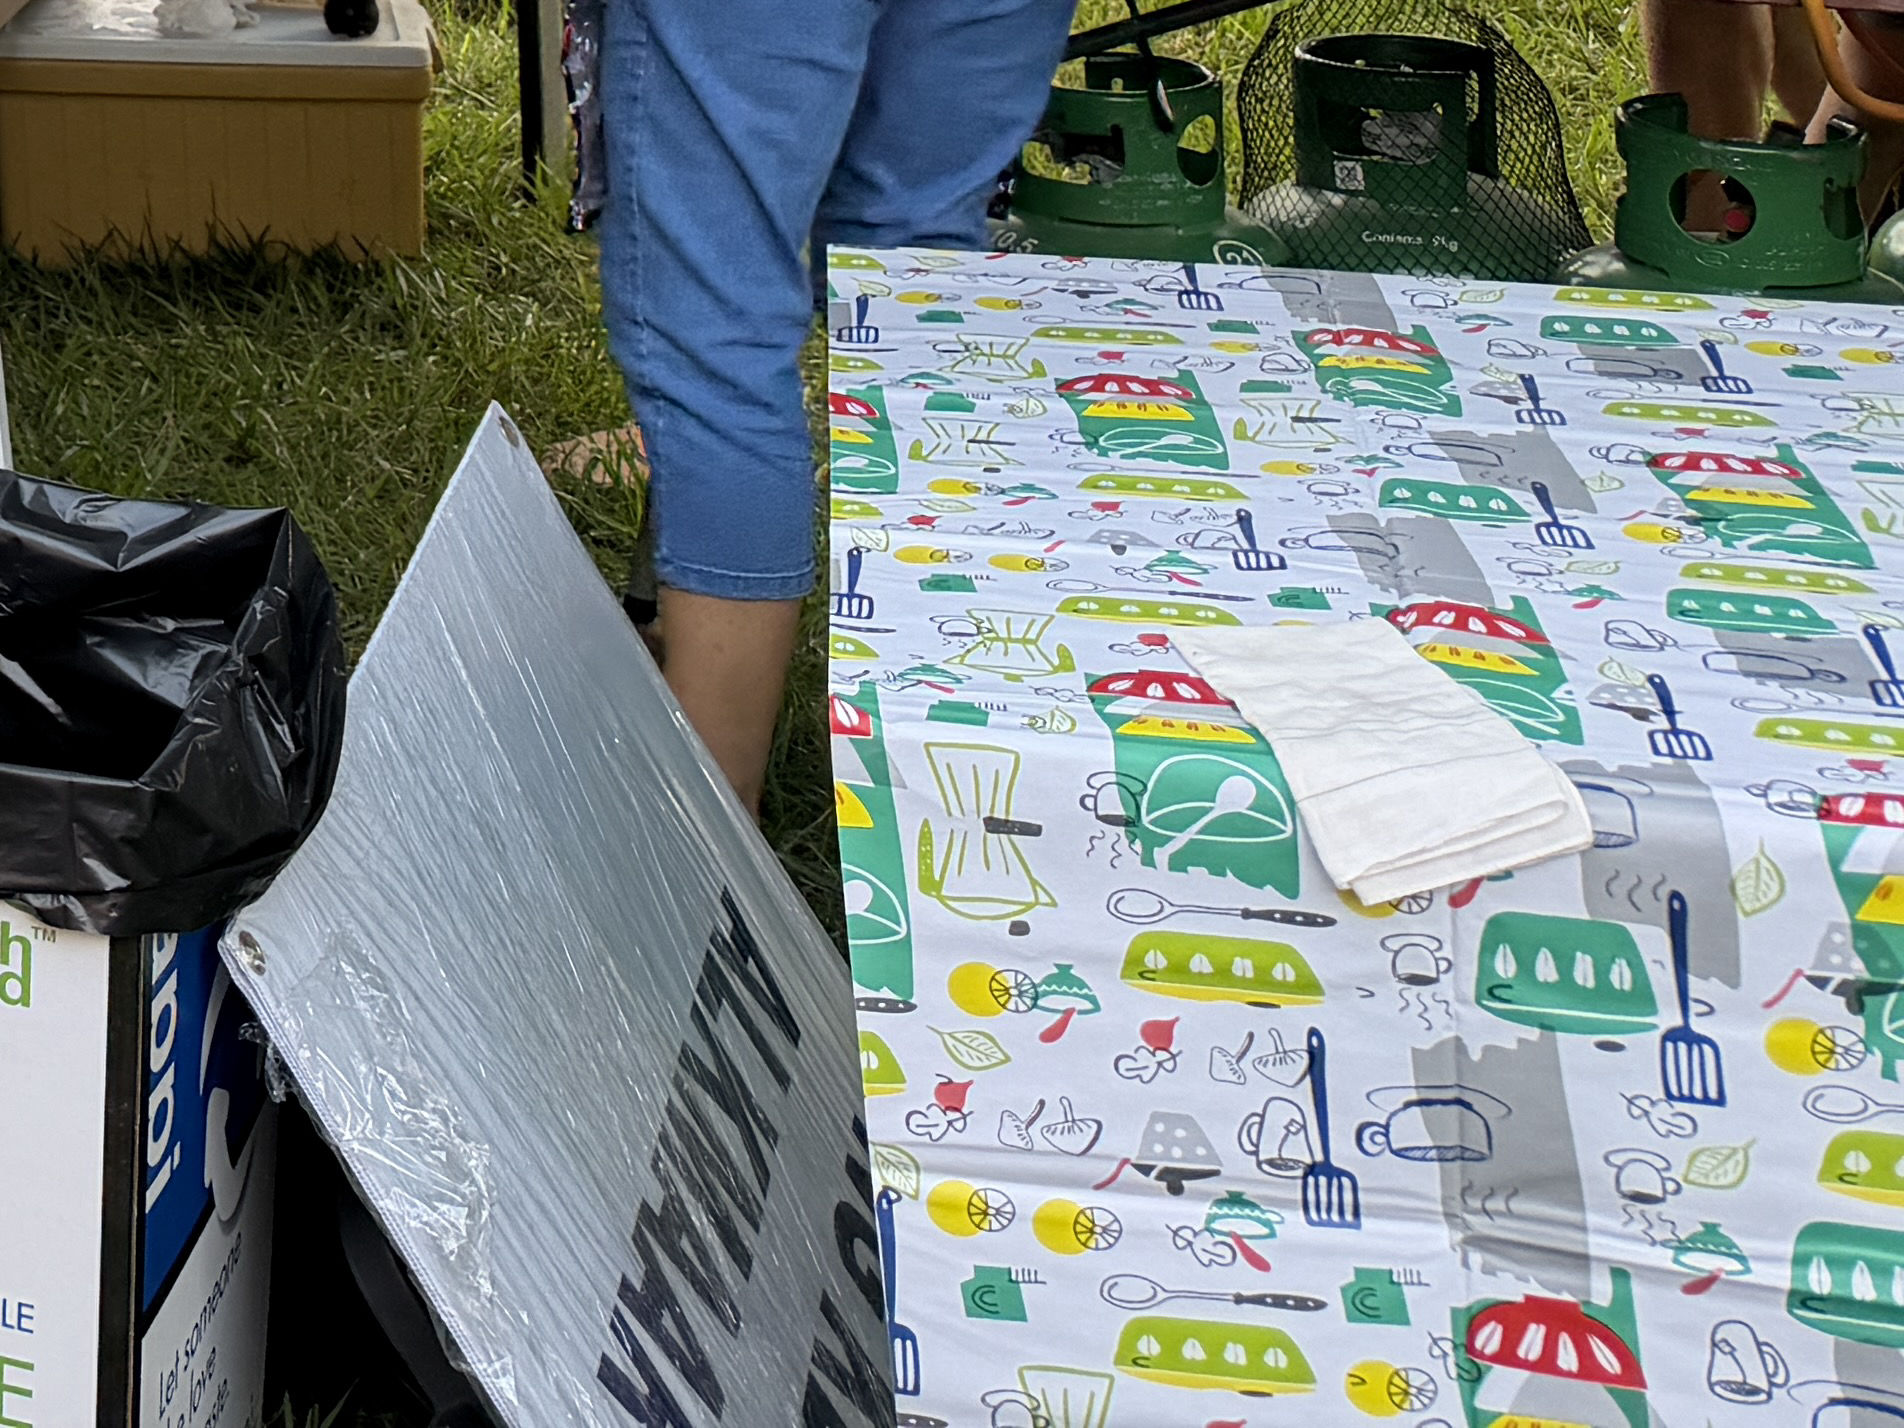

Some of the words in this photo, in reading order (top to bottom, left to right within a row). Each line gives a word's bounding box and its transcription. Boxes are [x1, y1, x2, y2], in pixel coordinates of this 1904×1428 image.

[145, 932, 182, 1214] appi
[158, 1348, 181, 1420] Let
[183, 1232, 243, 1362] someone
